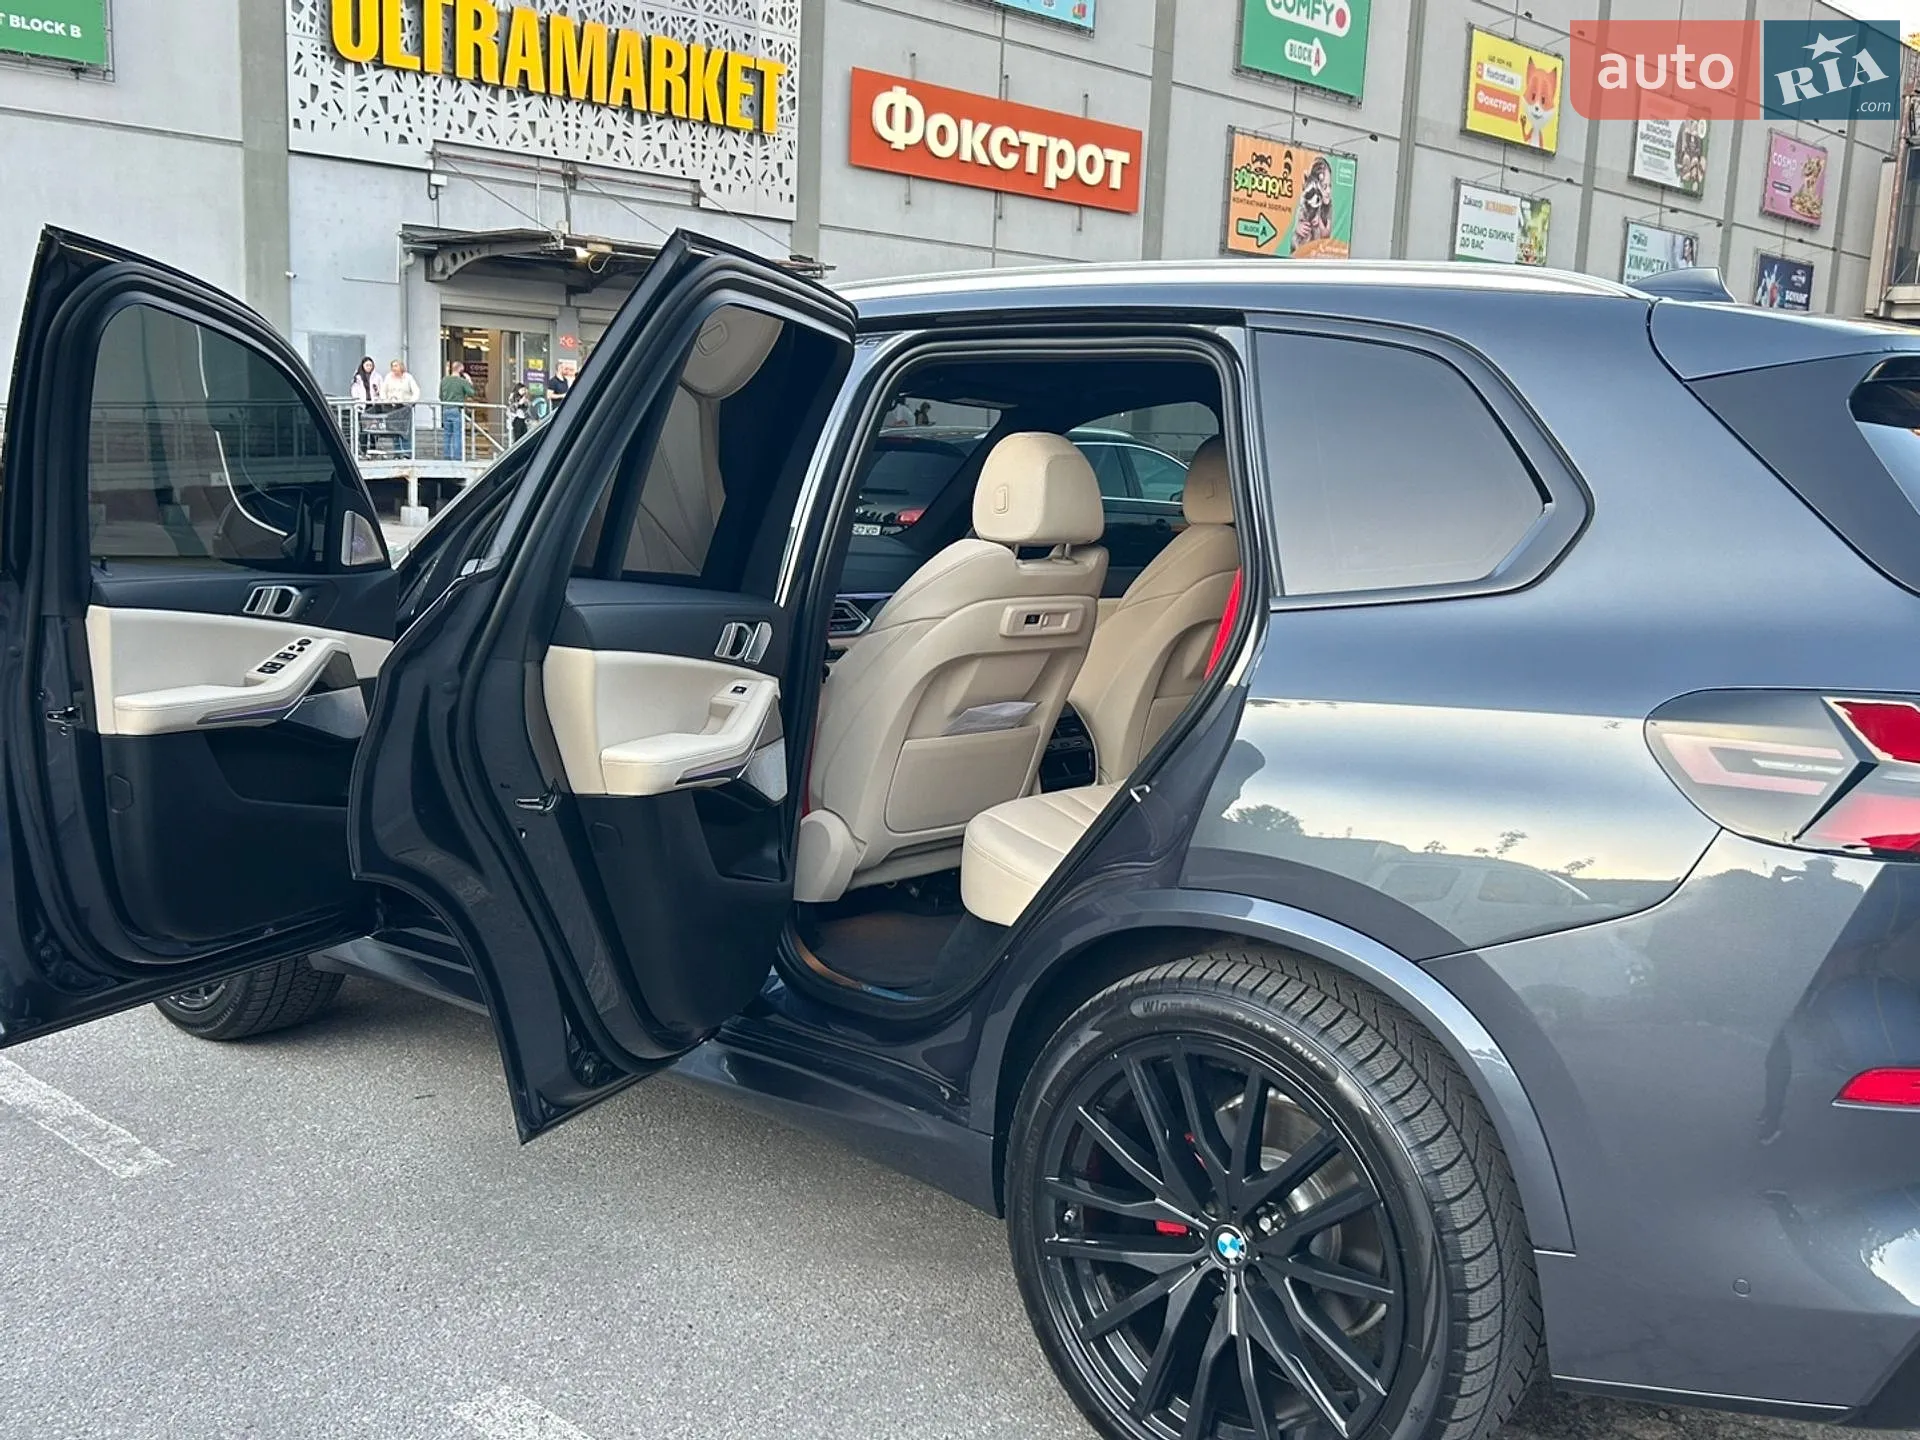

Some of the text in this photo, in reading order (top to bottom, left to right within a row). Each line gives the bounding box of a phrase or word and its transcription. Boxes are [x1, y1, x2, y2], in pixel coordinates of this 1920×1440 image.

[9, 13, 67, 37] BLOCK
[69, 25, 82, 38] B
[1289, 43, 1320, 66] BLOCK A
[330, 0, 788, 135] ULTRAMARKET
[871, 85, 1131, 190] Фокстрот
[1260, 225, 1268, 237] A
